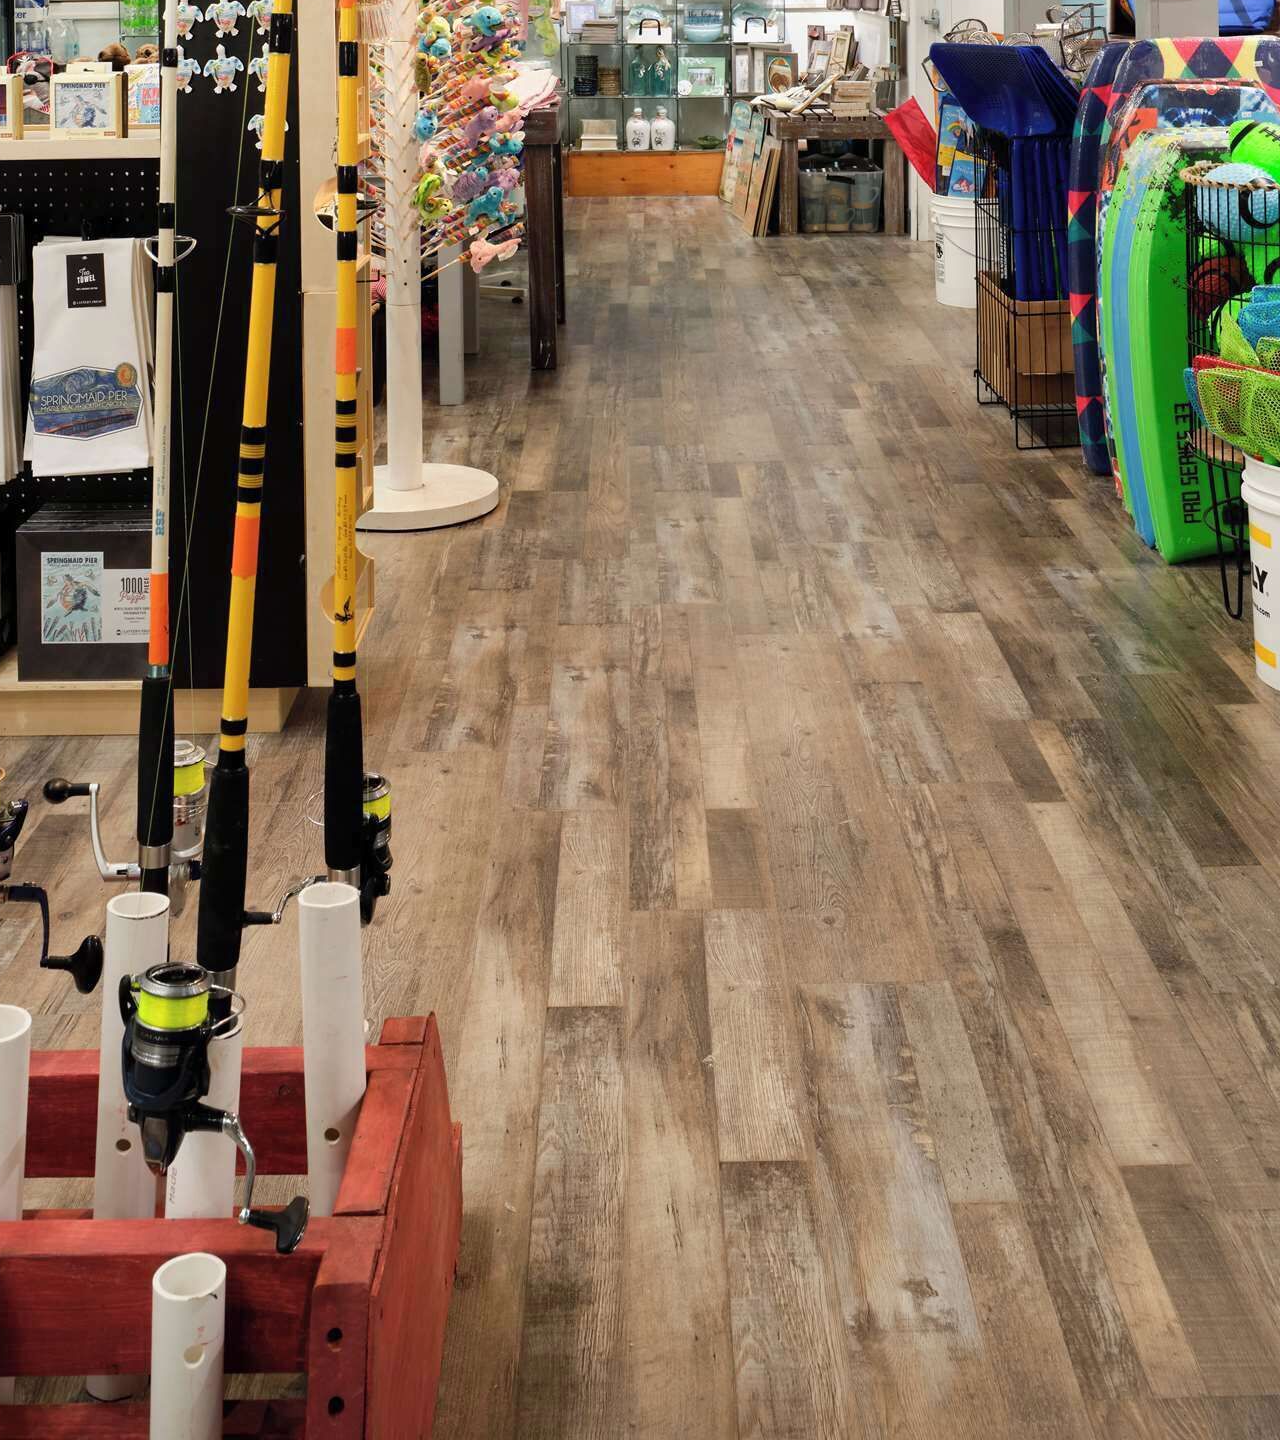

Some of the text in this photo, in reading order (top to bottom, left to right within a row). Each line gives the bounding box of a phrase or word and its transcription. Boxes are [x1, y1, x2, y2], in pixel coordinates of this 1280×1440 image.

[76, 274, 96, 285] TOWEL
[41, 389, 128, 407] SPRINGMAID PIER
[1174, 402, 1190, 426] 33
[1181, 491, 1201, 524] PRO
[120, 576, 143, 594] 1000
